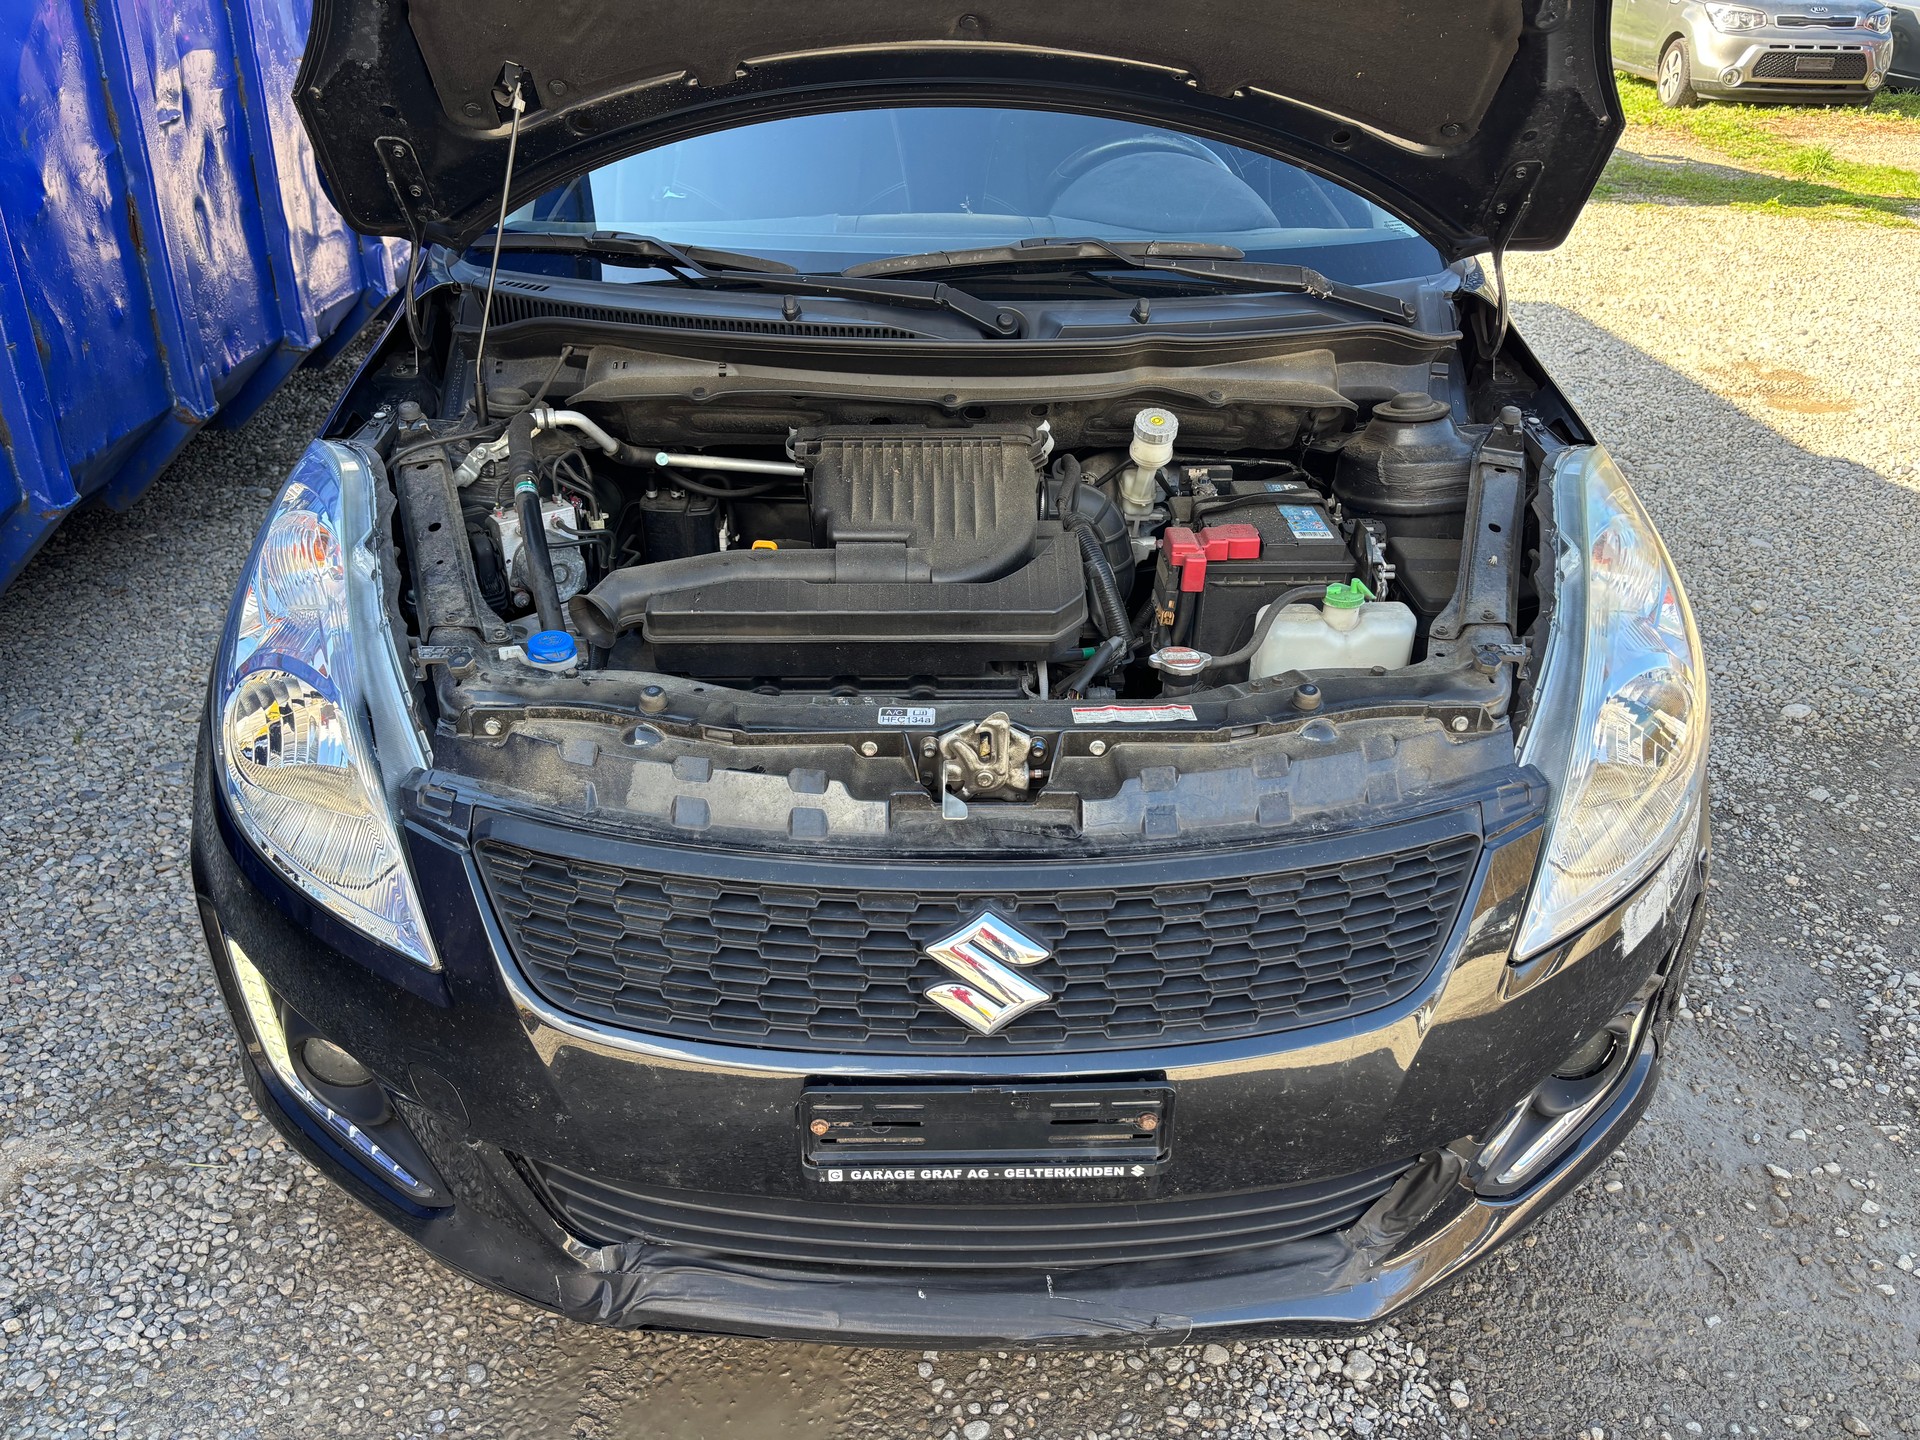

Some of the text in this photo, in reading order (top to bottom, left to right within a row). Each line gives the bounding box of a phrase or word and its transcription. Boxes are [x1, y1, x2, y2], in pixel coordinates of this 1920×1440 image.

[850, 1170, 915, 1180] GARAGE
[920, 1169, 963, 1179] GRAF
[967, 1169, 989, 1179] AG
[1004, 1166, 1125, 1178] GELTERKINDEN
